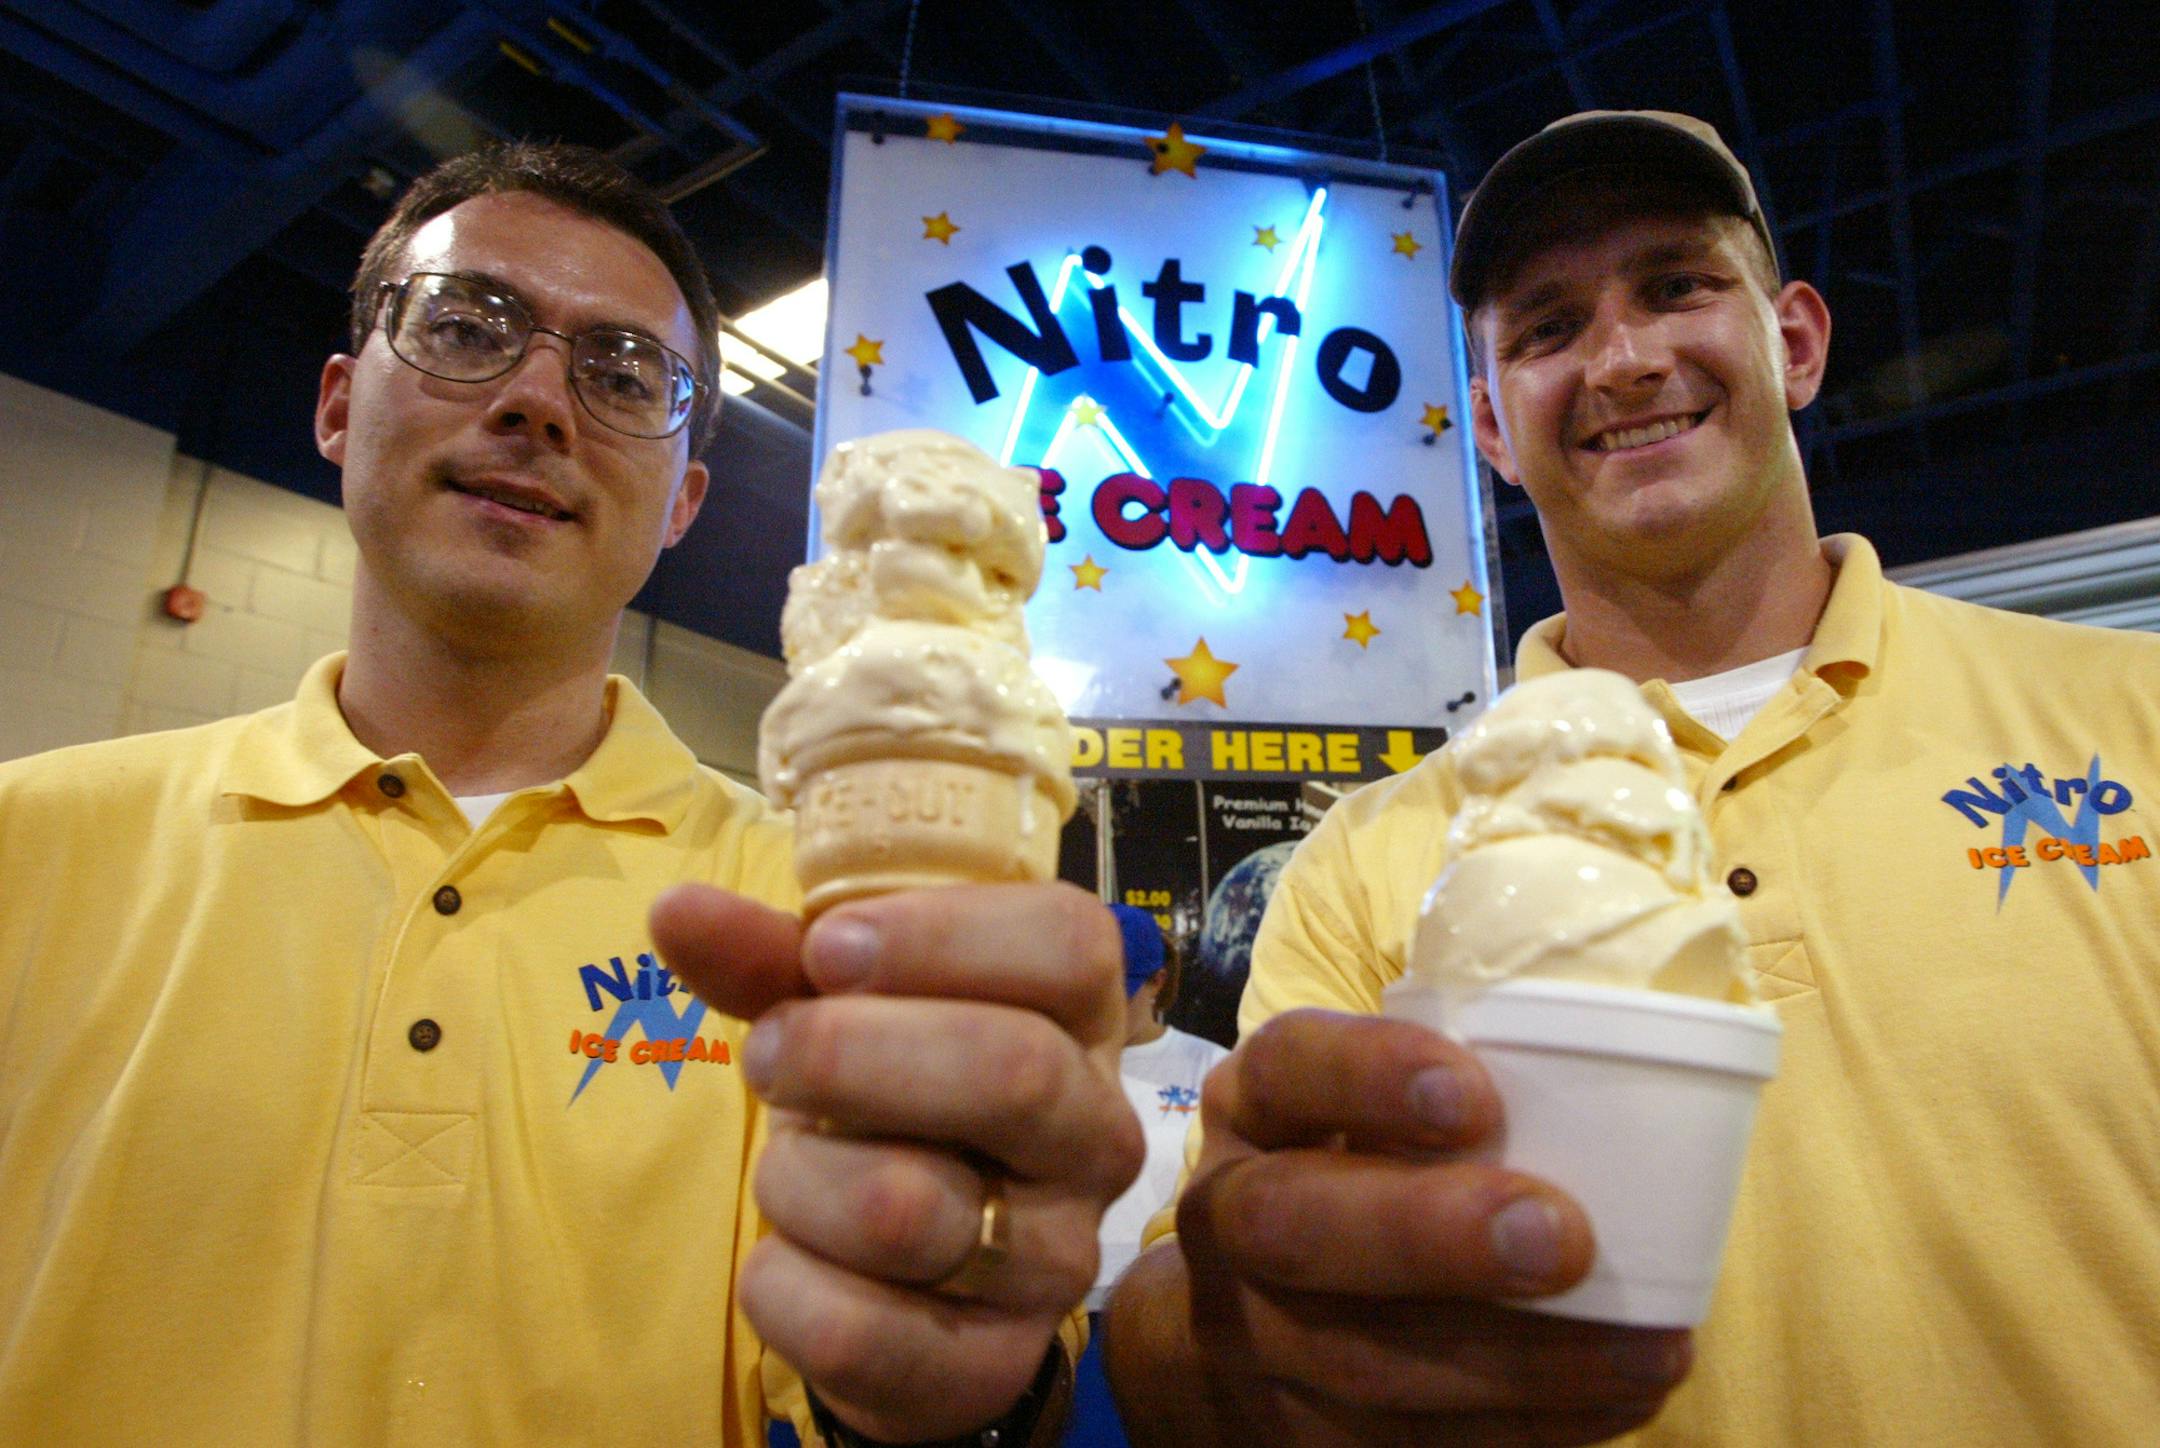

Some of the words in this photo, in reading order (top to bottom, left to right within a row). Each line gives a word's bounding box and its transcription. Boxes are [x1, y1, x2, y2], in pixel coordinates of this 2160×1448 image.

[925, 245, 1401, 413] Nitro
[1091, 472, 1433, 568] CREAM
[1071, 728, 1184, 770] DER
[1211, 731, 1361, 772] HERE
[1213, 794, 1289, 811] Premium
[1941, 763, 2134, 829] Nitro
[1222, 814, 1282, 830] Vanilla
[1967, 845, 2031, 870] ICE
[1125, 888, 1171, 908] $2.00
[578, 953, 692, 1012] Nit
[569, 1028, 621, 1064] ICE
[629, 1035, 732, 1066] CREAM
